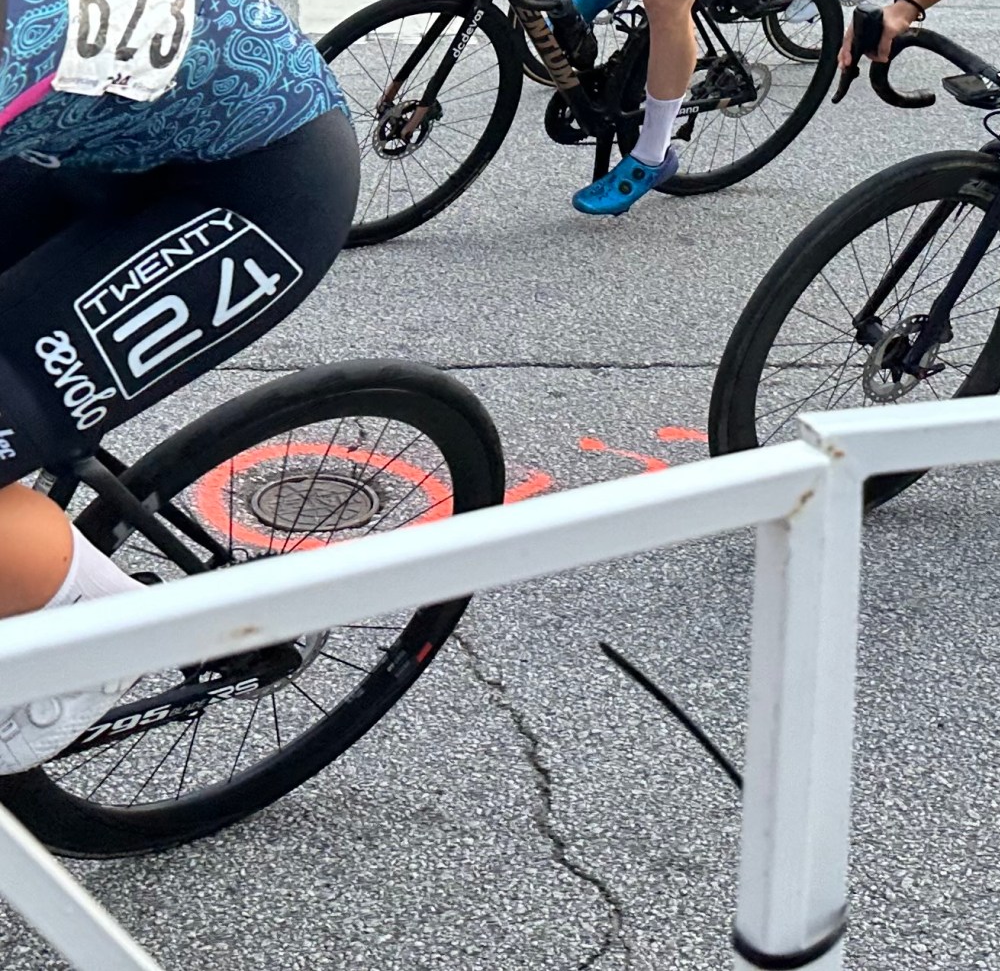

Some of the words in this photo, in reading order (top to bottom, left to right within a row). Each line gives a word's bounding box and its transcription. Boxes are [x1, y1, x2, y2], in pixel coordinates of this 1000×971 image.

[83, 212, 235, 316] TWENTY
[113, 257, 281, 379] 24
[82, 703, 171, 745] 795
[206, 678, 260, 704] RS
